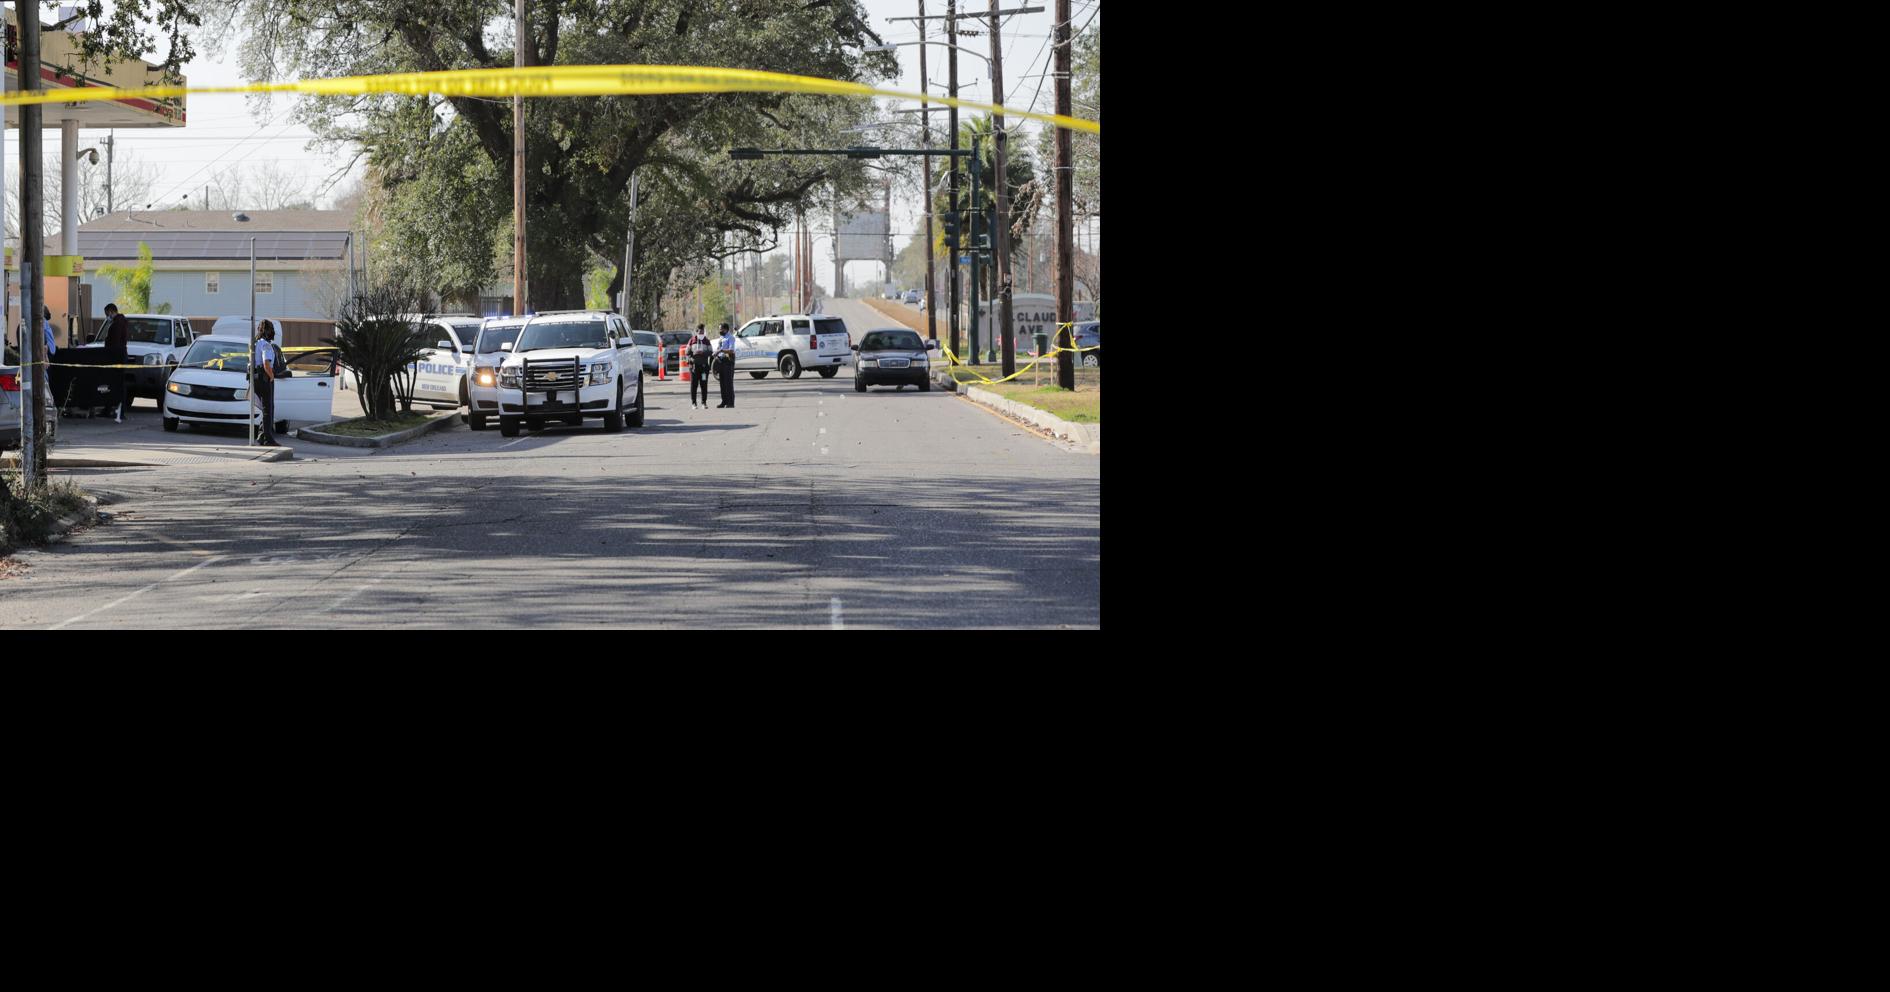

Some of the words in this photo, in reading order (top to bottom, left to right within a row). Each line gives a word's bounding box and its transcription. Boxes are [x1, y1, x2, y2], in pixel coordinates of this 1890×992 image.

[1017, 312, 1056, 322] CLAUD
[1019, 325, 1043, 335] AVE
[418, 363, 454, 376] POLICE
